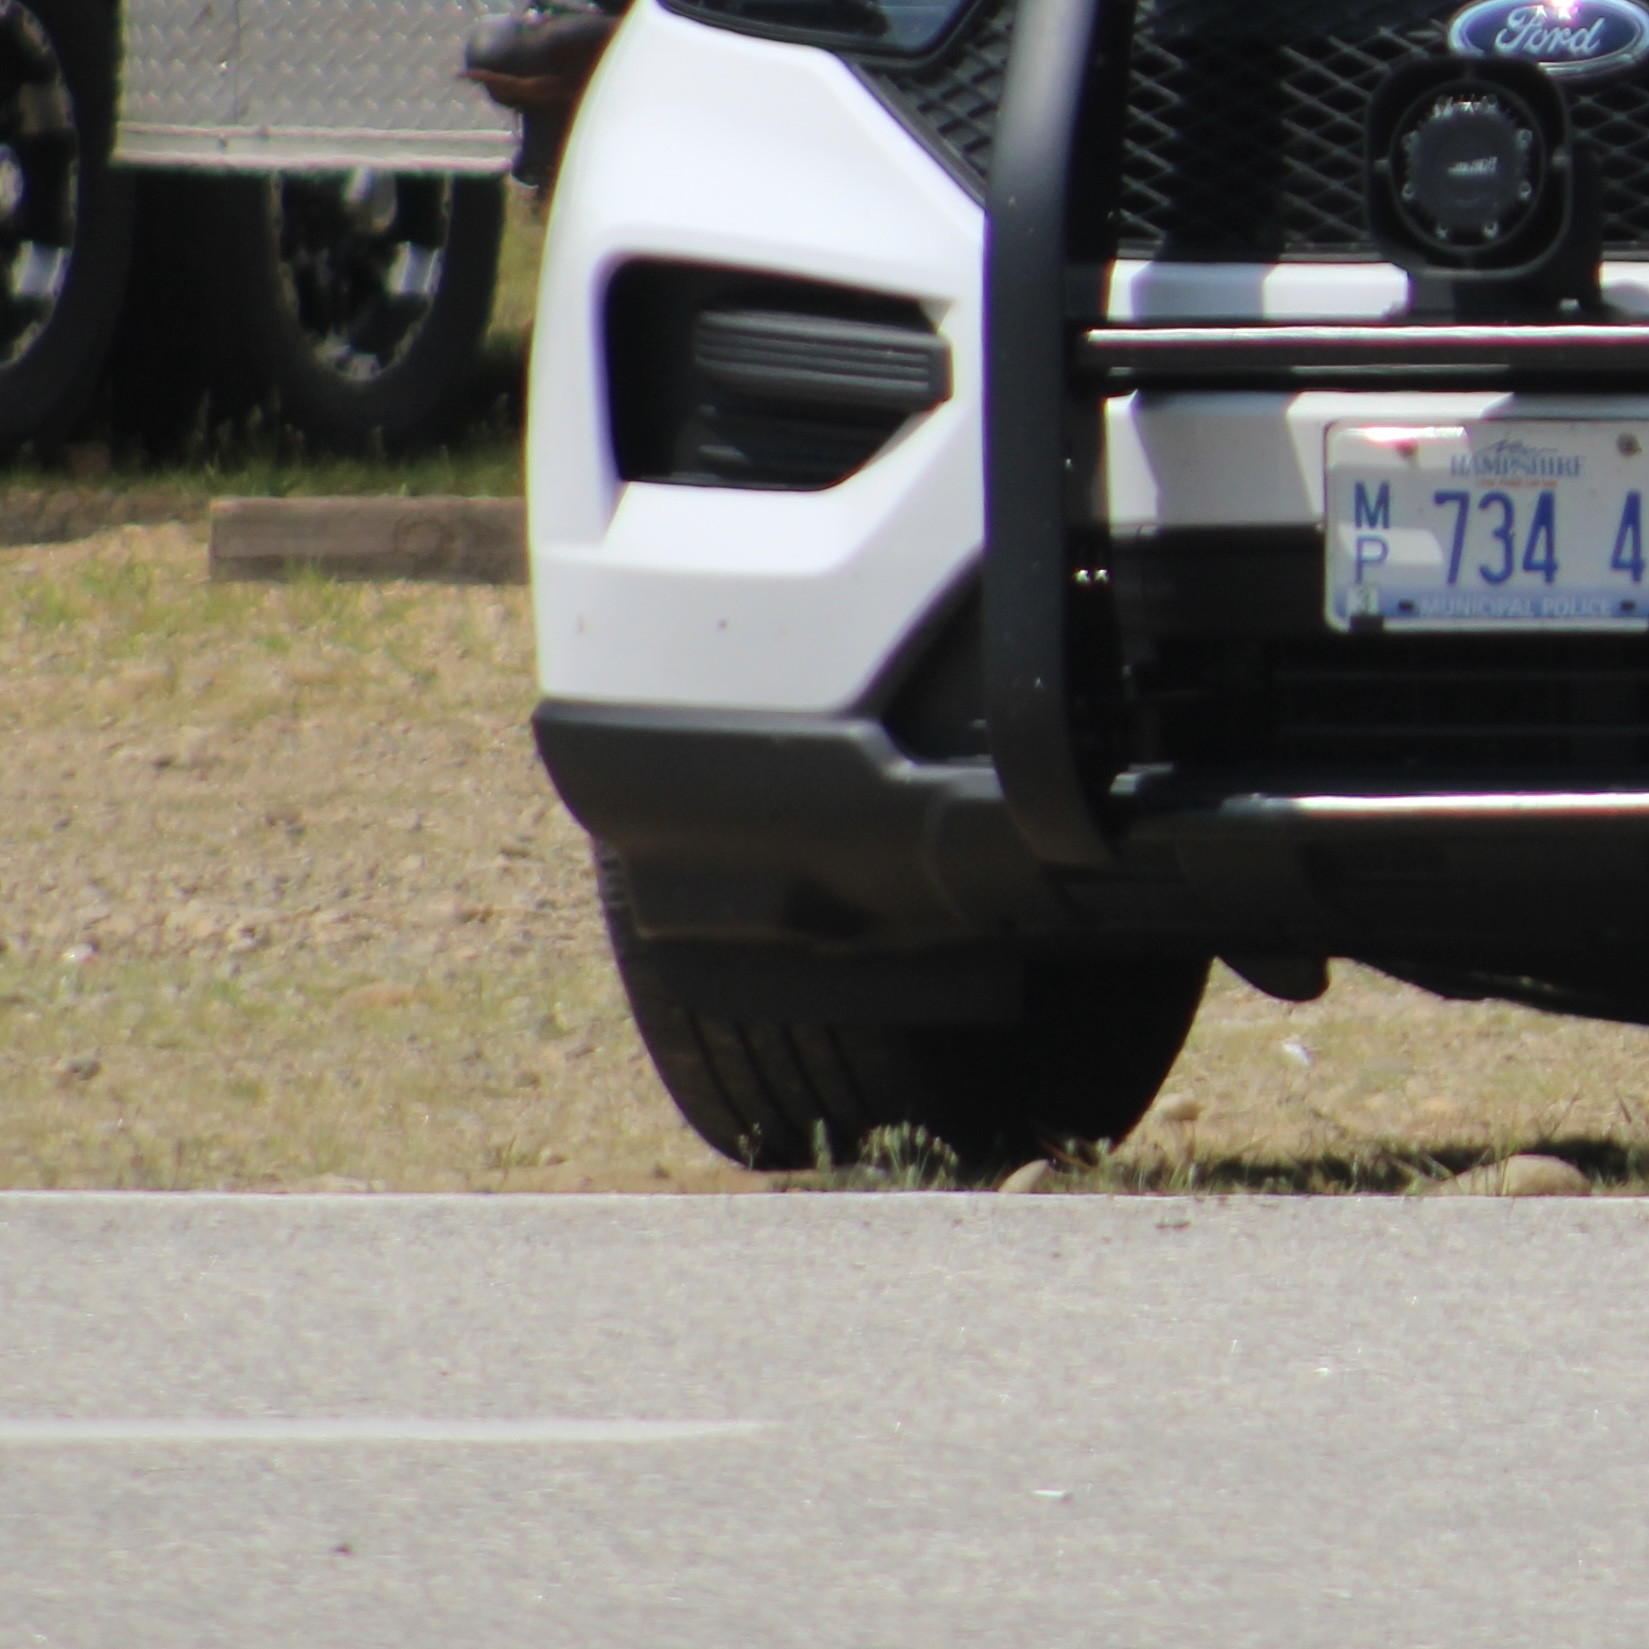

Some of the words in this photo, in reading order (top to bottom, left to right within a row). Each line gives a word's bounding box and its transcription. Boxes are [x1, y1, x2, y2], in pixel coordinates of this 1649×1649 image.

[1494, 4, 1606, 54] Ford
[1433, 490, 1559, 585] 734
[1610, 490, 1646, 584] 4
[1419, 596, 1534, 617] MUNICIPAL
[1542, 596, 1612, 617] POLICE
